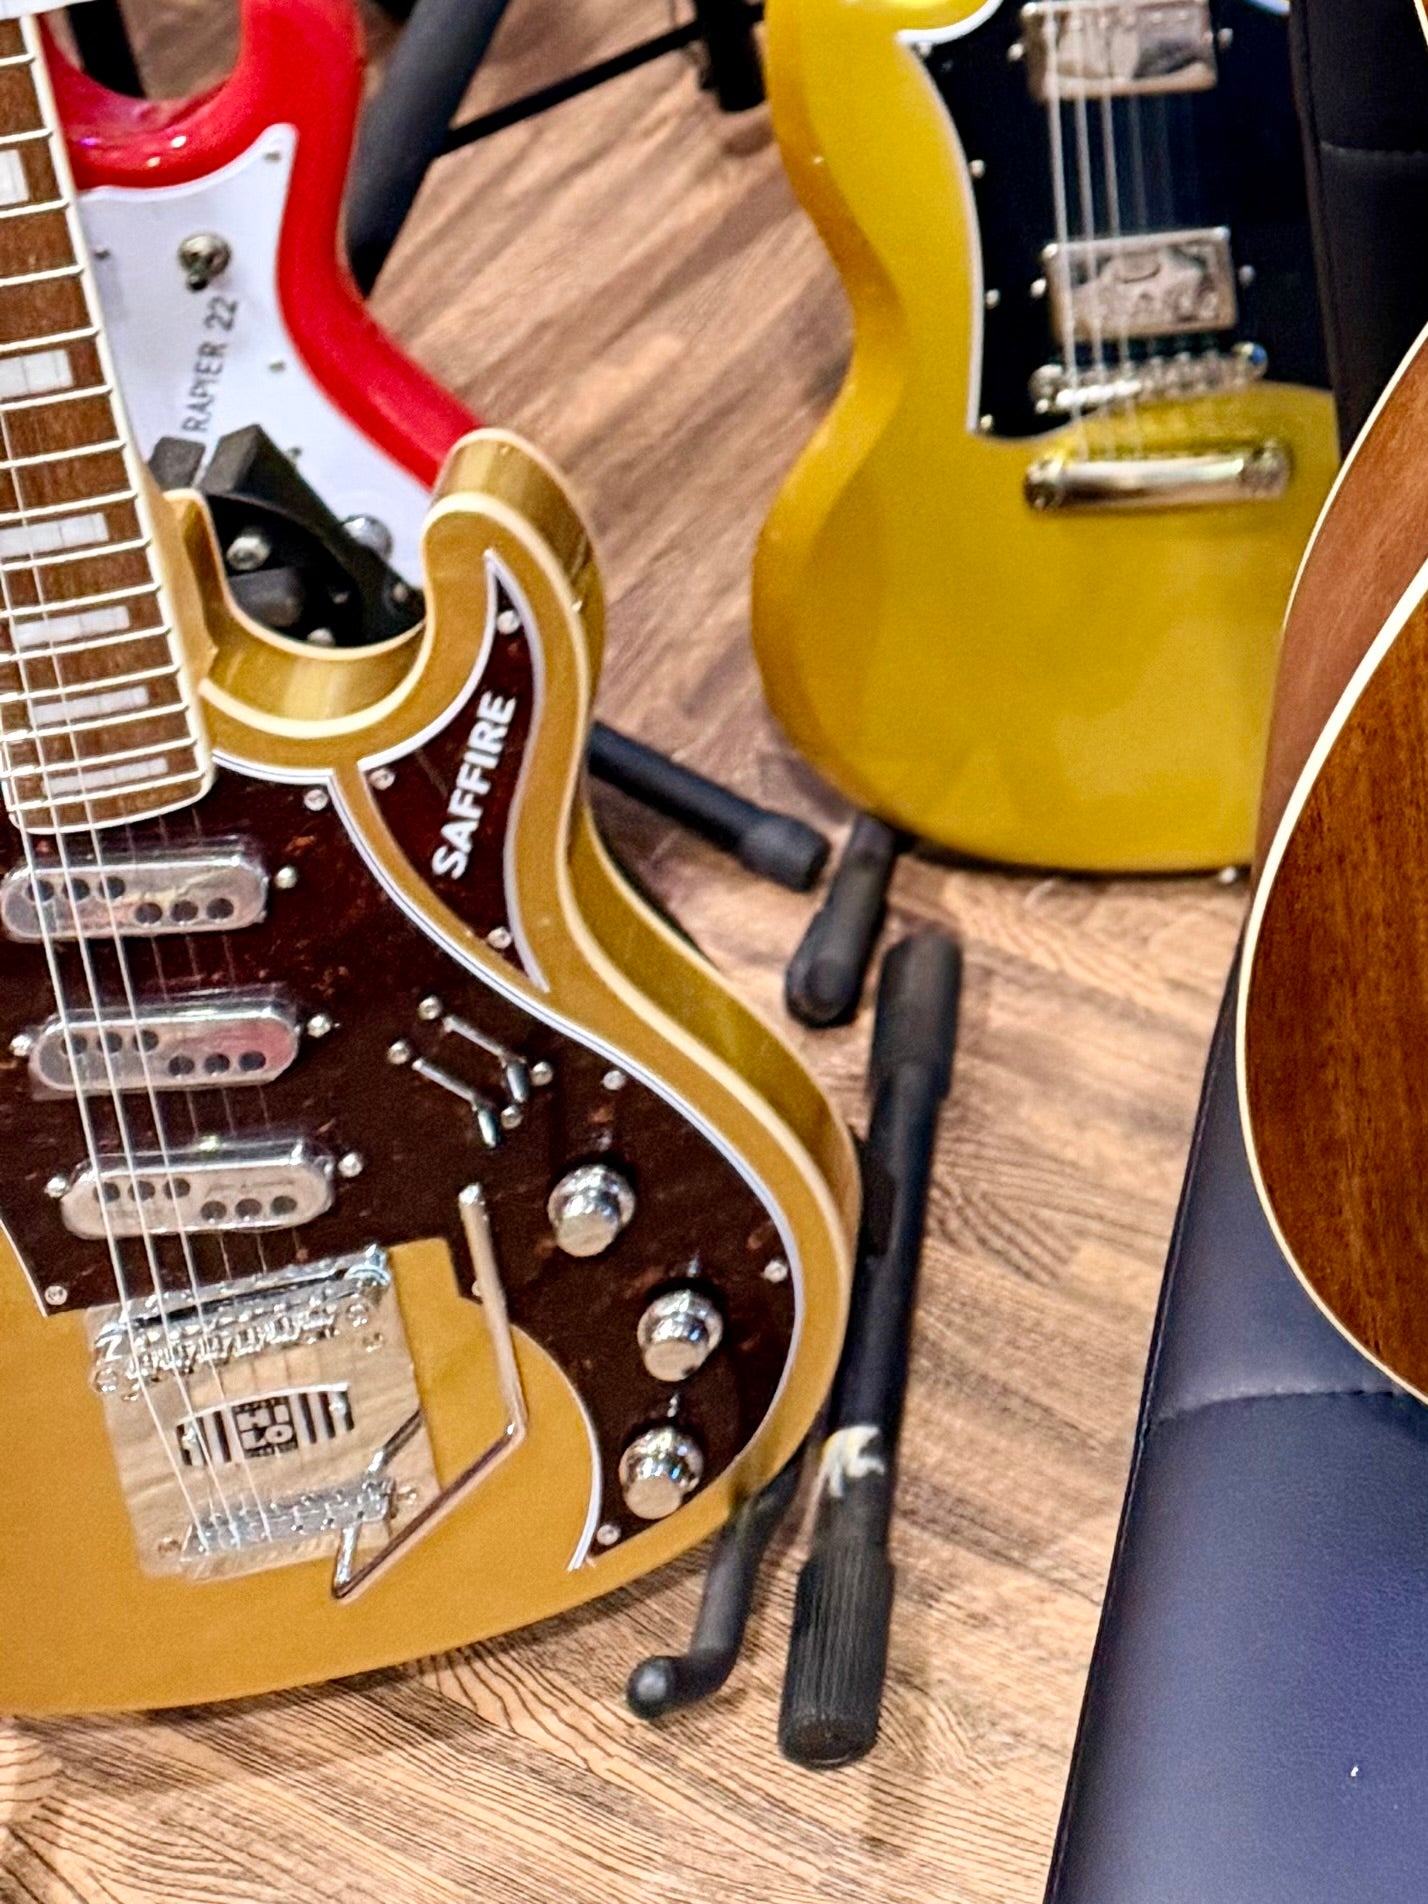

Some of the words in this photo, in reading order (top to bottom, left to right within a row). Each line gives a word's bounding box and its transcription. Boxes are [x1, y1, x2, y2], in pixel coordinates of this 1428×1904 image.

[203, 294, 238, 332] 22
[180, 341, 227, 434] RAPIER
[431, 689, 517, 881] SAFFIRE
